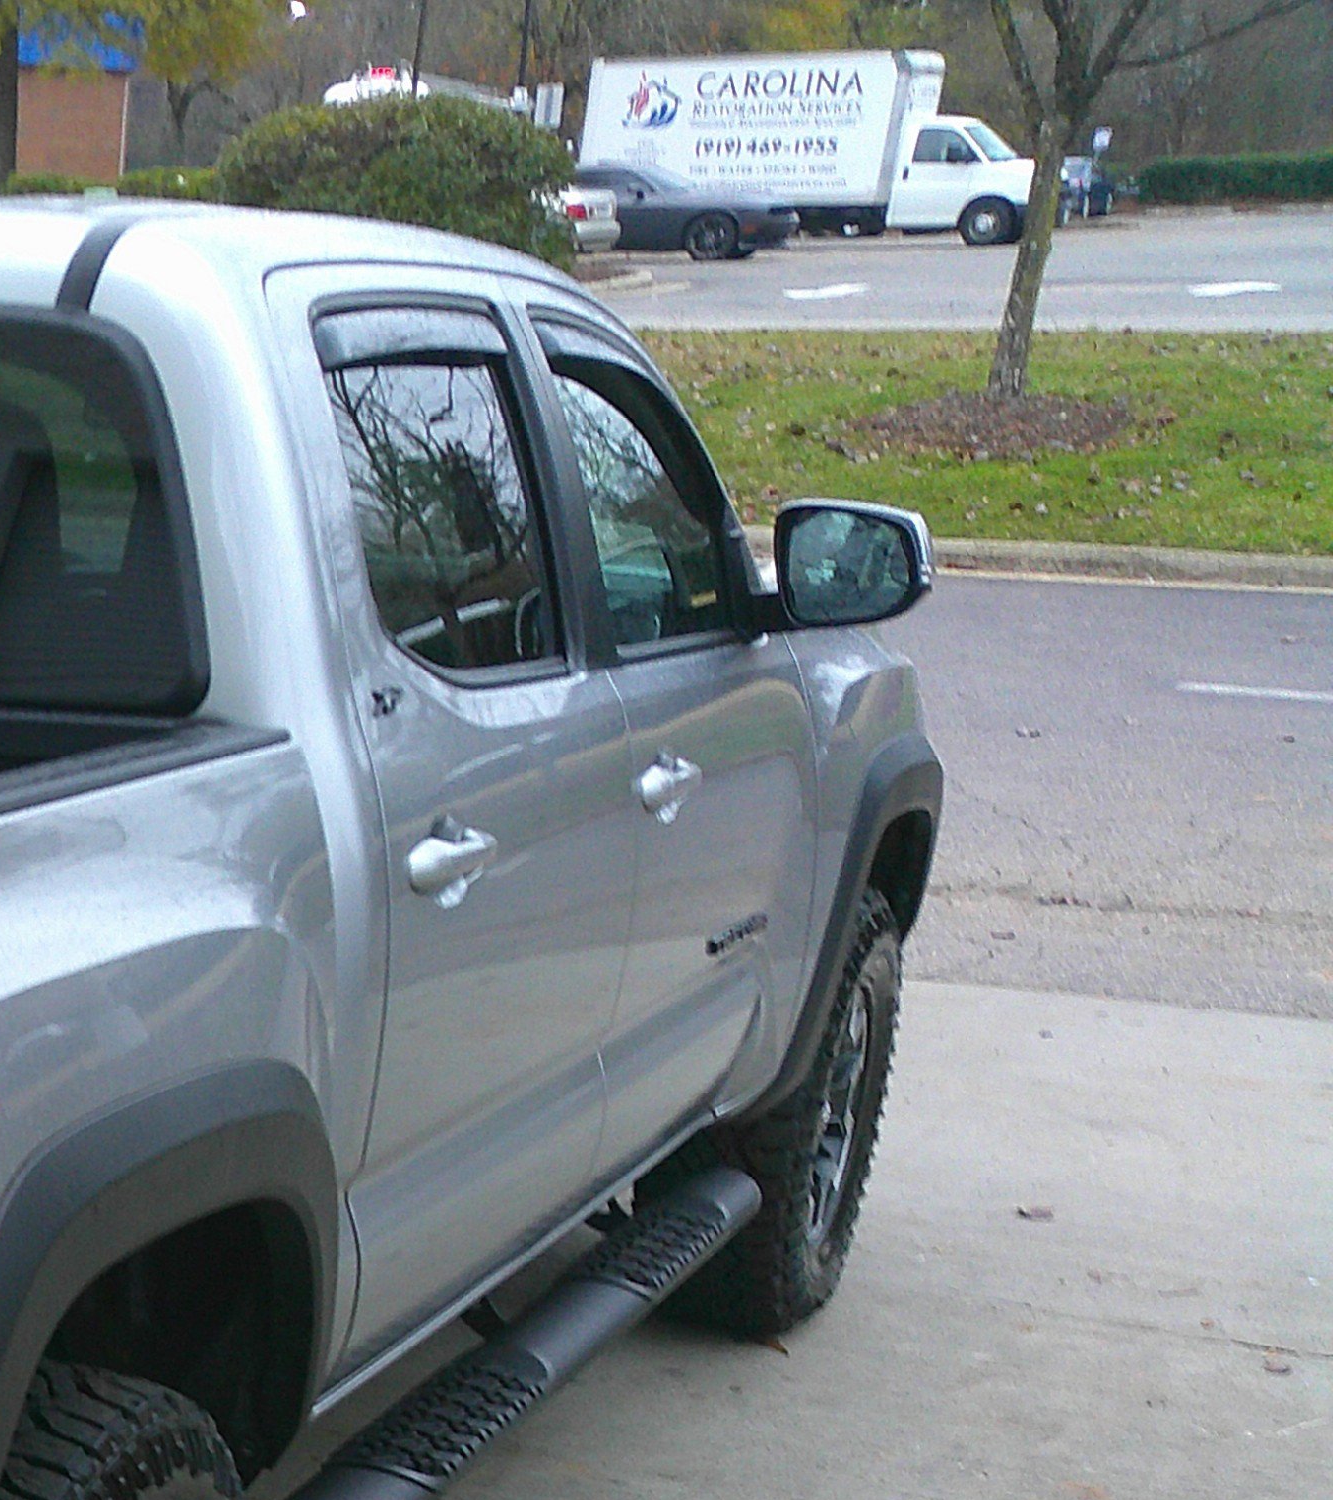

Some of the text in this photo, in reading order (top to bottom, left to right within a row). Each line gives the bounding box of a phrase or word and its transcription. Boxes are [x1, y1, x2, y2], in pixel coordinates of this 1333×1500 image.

[697, 69, 863, 99] CAROLINA
[693, 100, 861, 118] RESTORATION SERVICES
